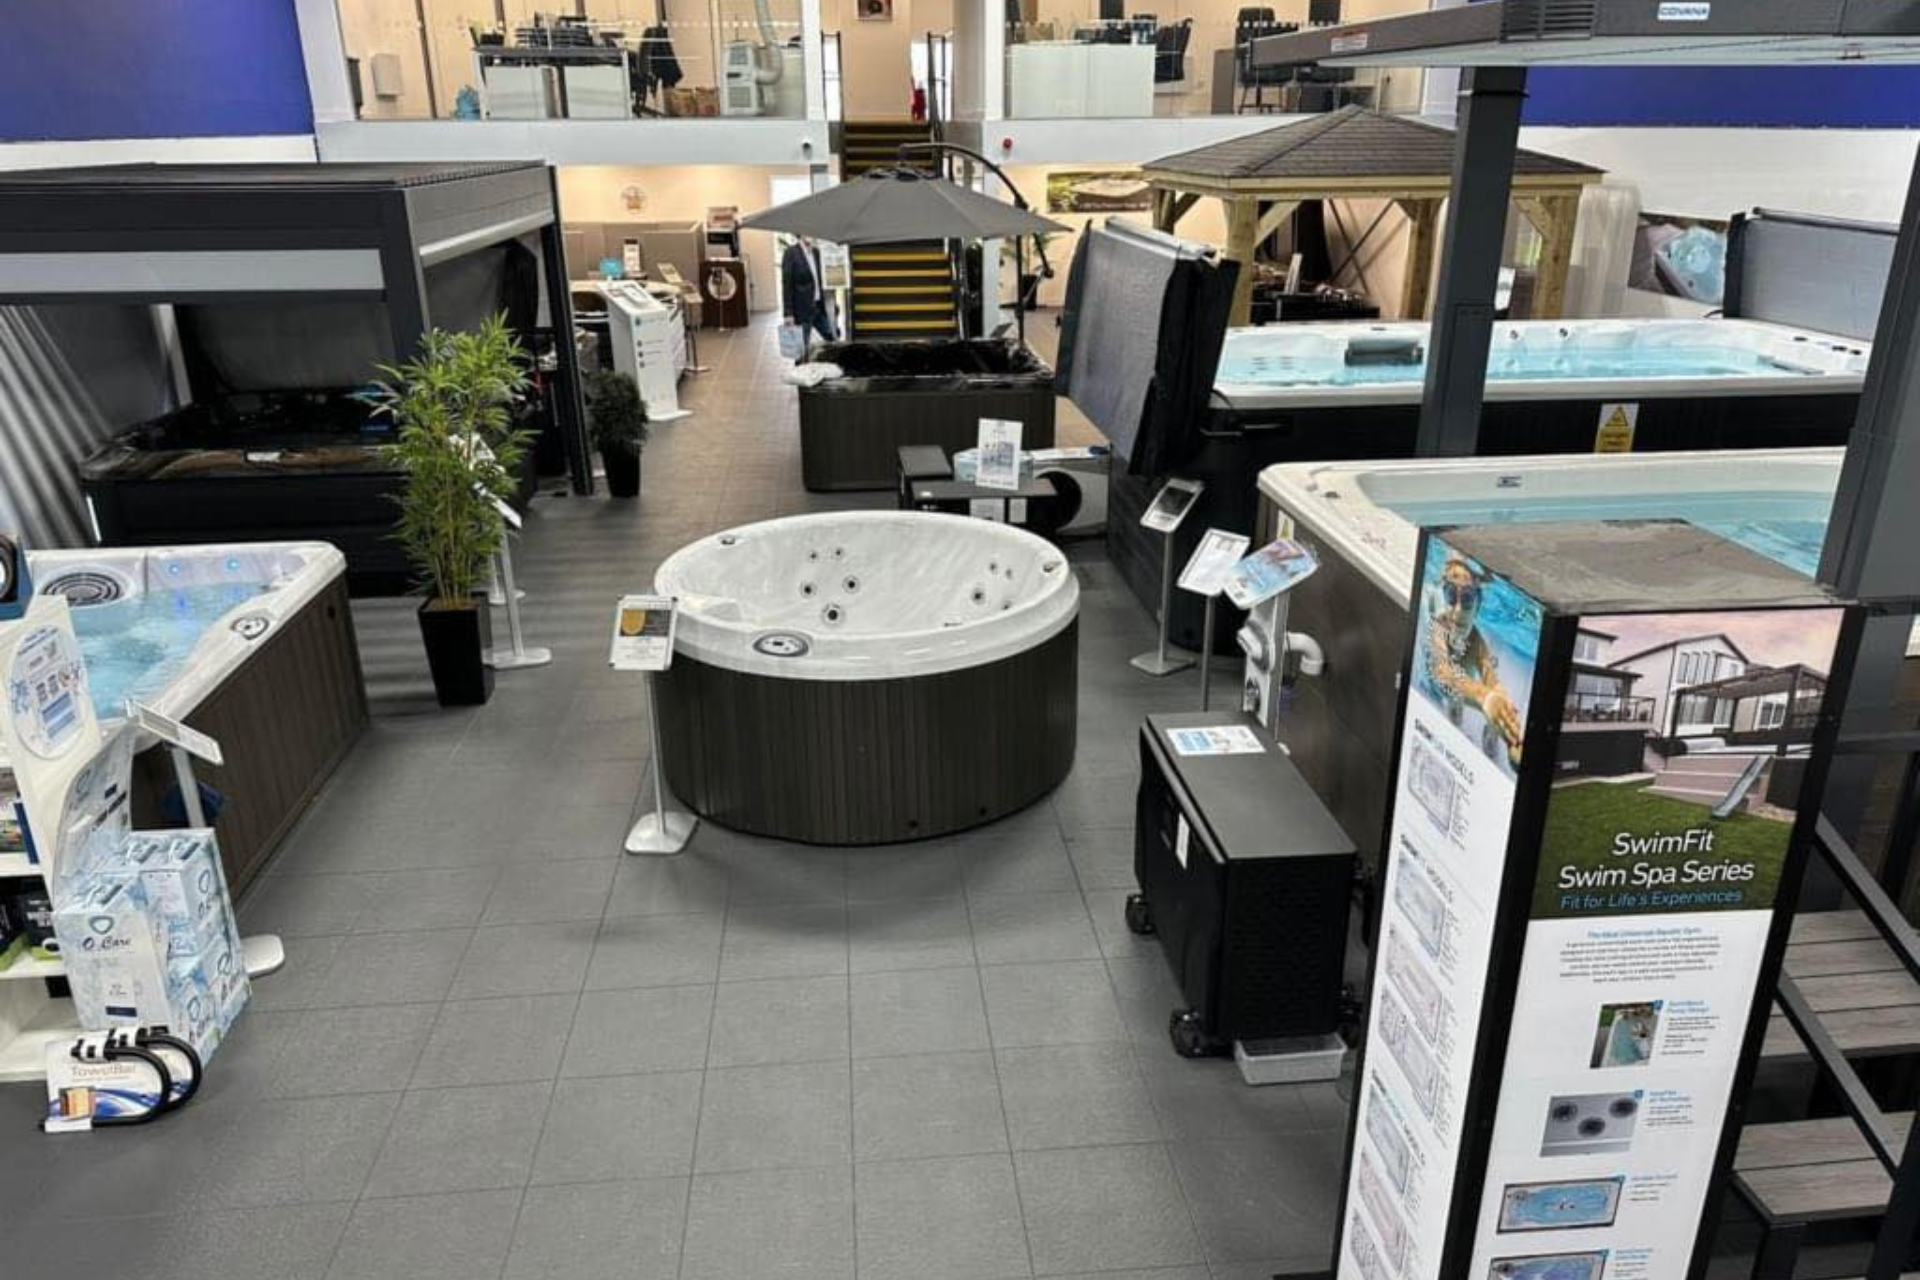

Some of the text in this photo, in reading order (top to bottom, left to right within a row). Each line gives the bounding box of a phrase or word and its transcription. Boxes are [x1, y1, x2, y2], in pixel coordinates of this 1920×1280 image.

[1612, 829, 1715, 856] SwimFit
[1558, 859, 1755, 889] Swim Spa Series
[1561, 890, 1742, 909] Fit for Life's Experiences
